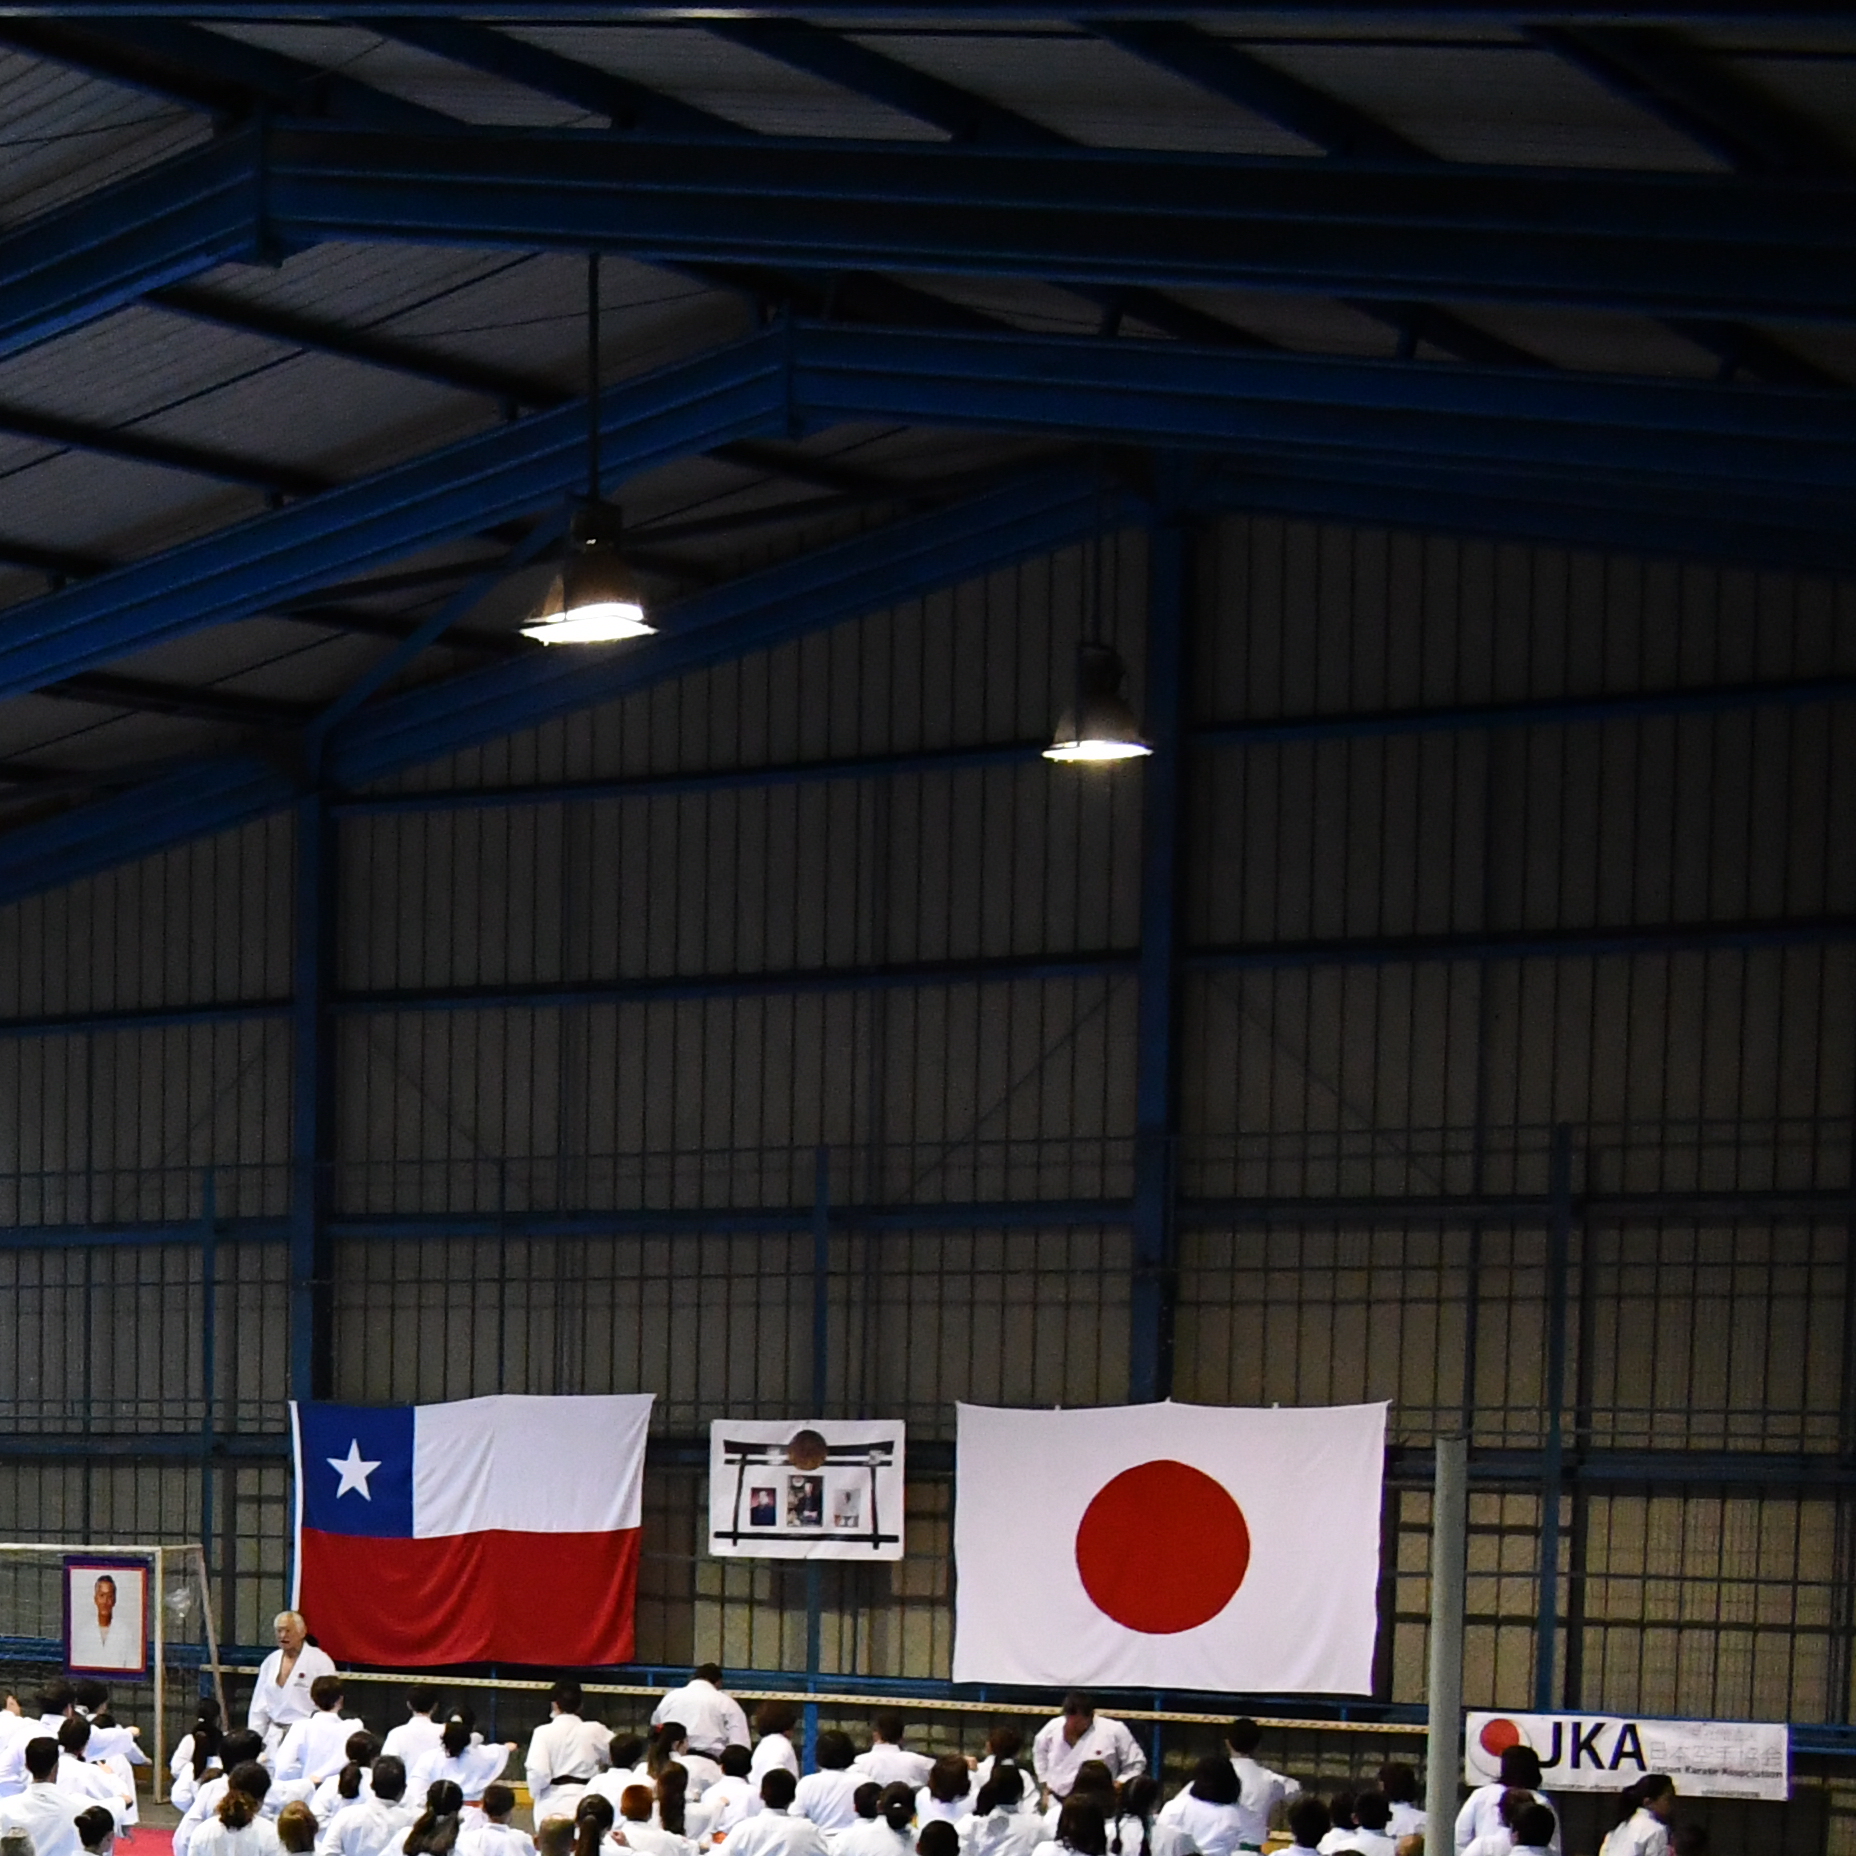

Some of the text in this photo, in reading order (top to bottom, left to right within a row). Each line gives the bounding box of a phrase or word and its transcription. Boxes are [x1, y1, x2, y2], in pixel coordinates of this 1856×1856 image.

[1538, 1721, 1647, 1772] JKA
[1685, 1766, 1719, 1776] Karate
[1721, 1768, 1784, 1778] Association
